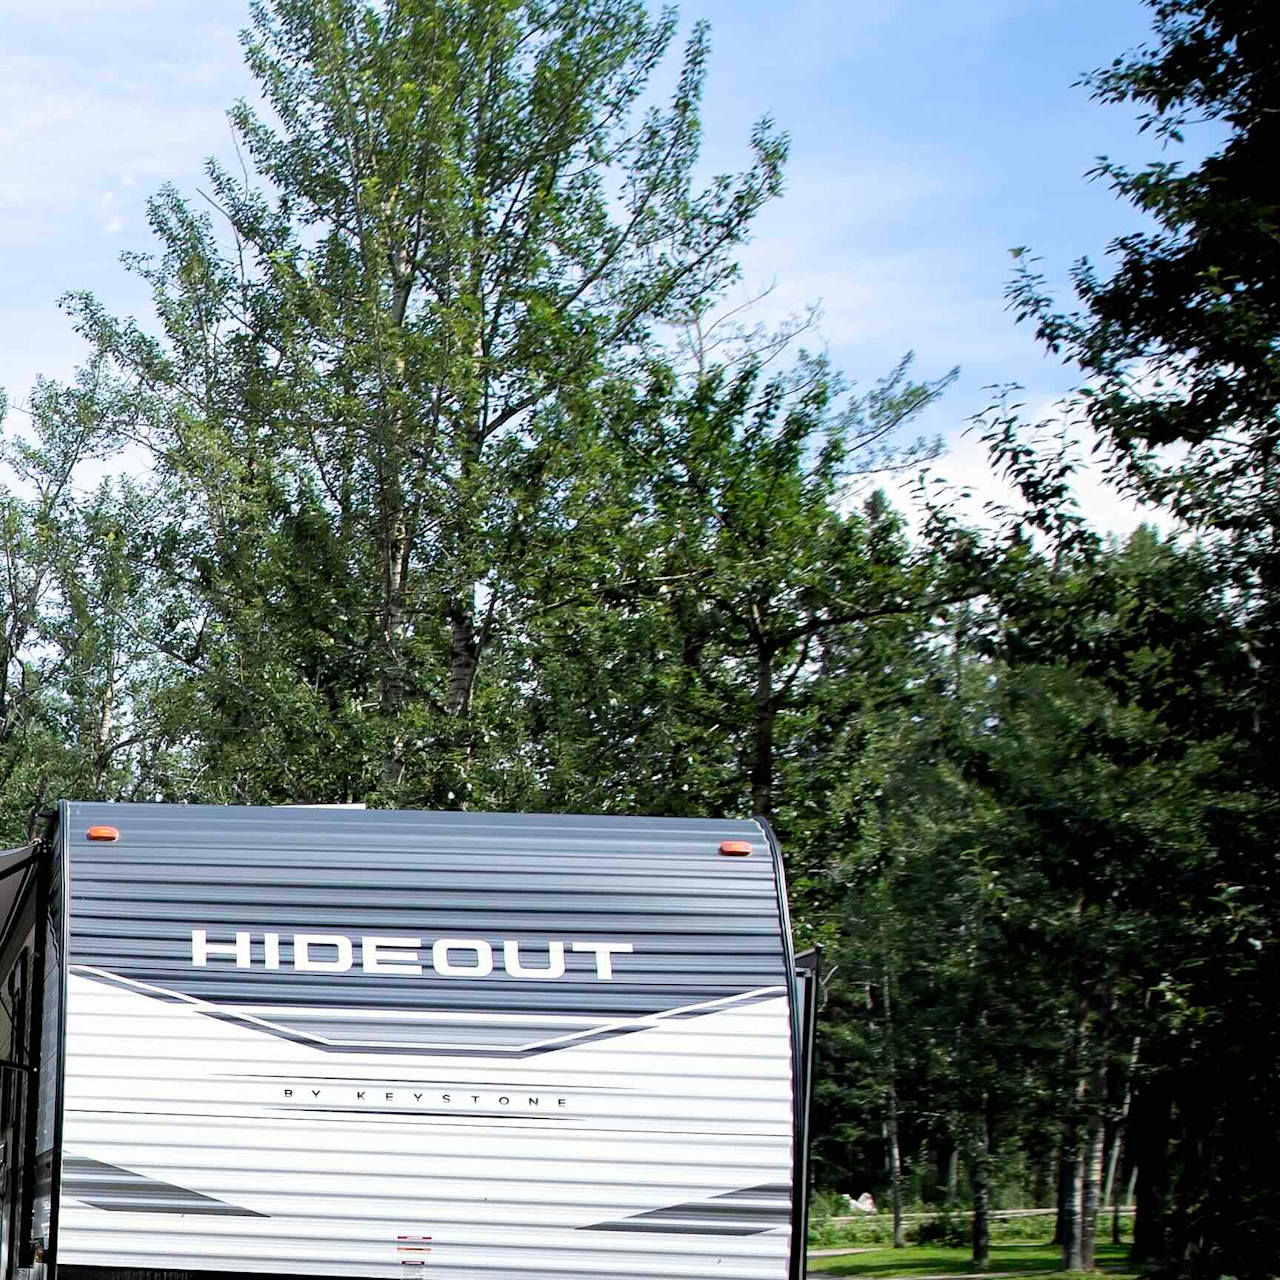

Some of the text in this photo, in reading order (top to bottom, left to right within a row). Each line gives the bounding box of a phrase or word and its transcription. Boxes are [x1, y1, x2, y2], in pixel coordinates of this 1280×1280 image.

[192, 929, 634, 980] HIDEOUT
[284, 1089, 567, 1107] BY KEYSTONE
